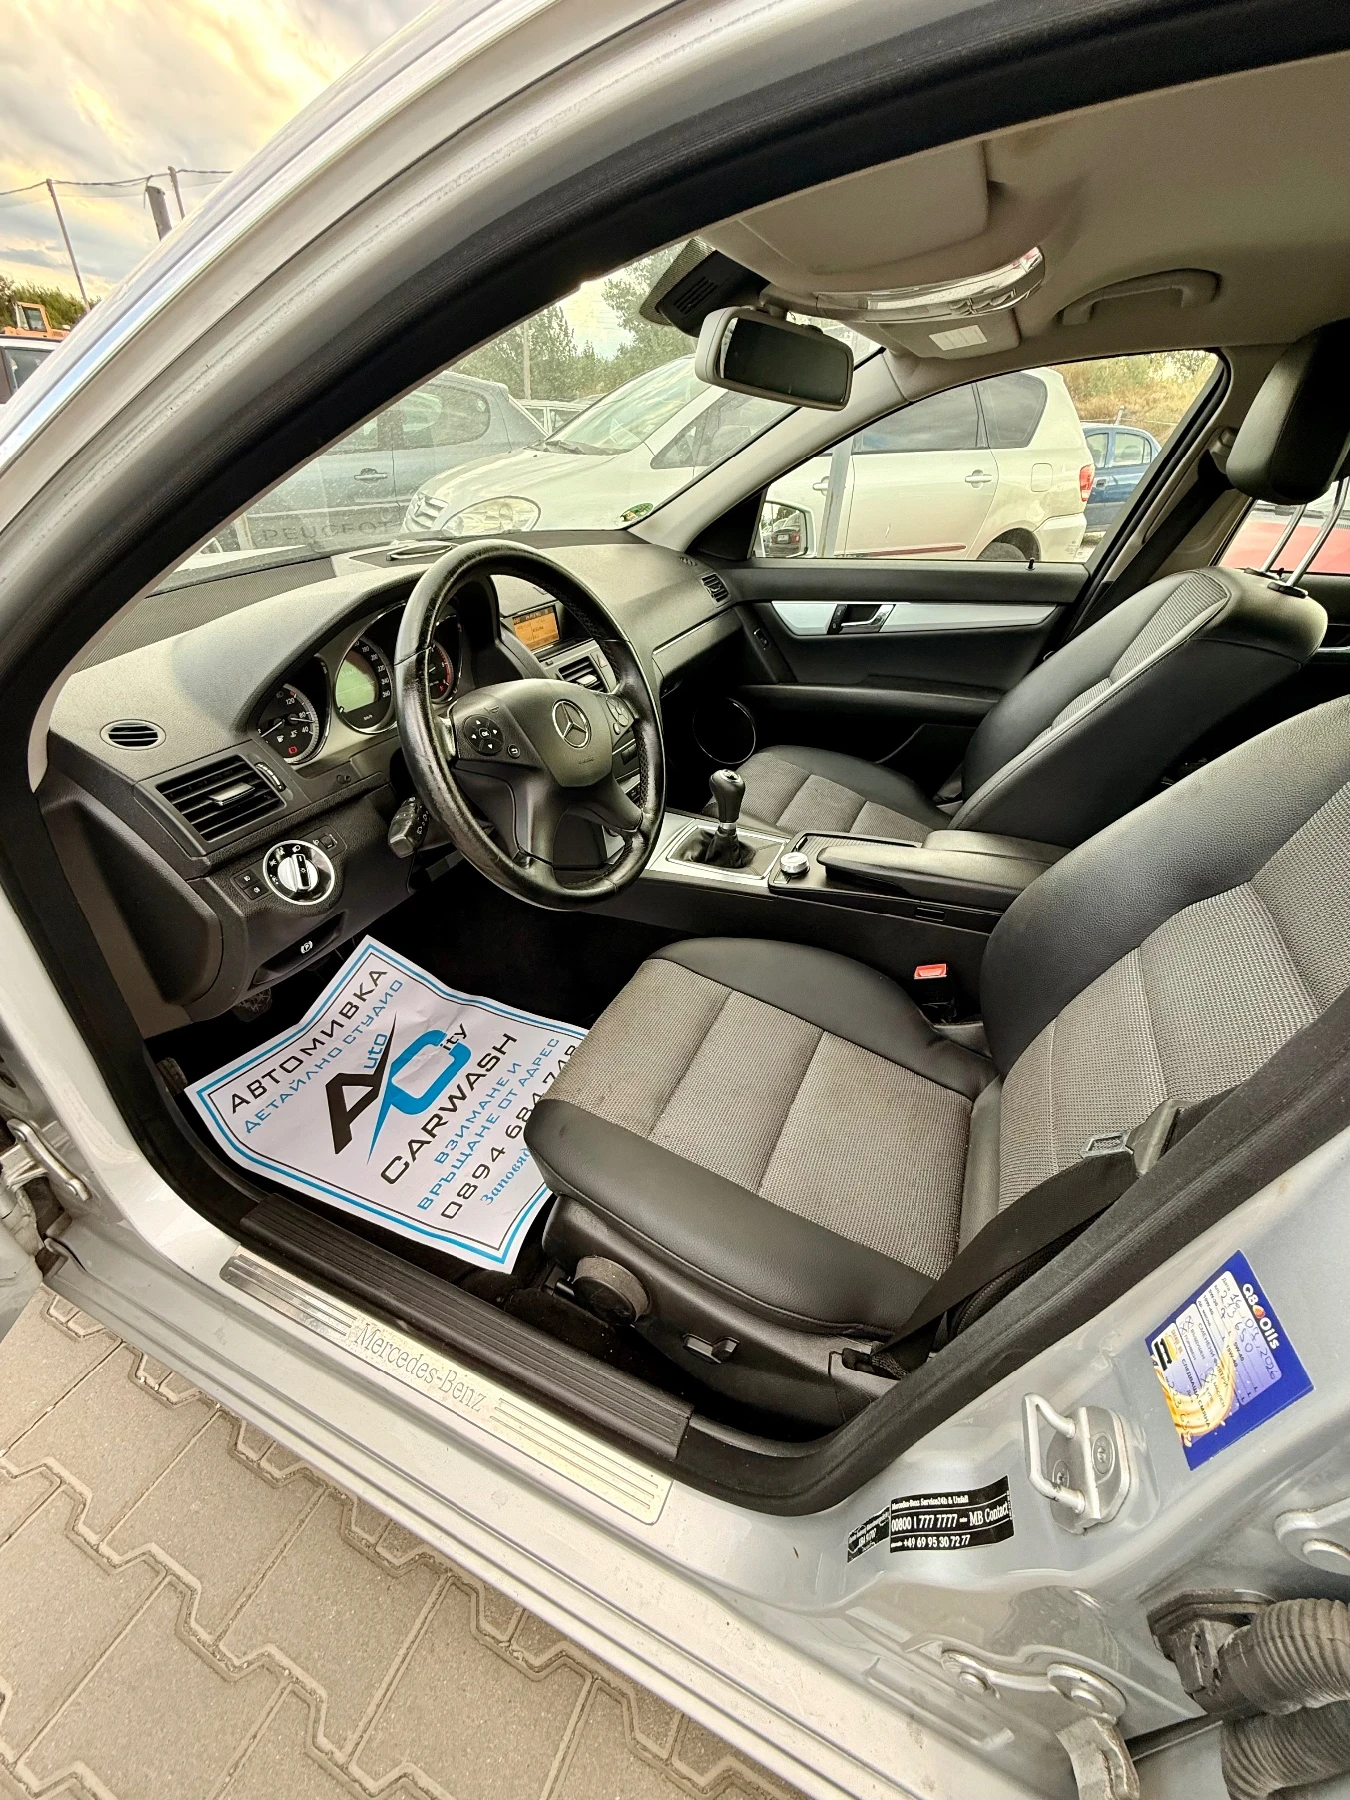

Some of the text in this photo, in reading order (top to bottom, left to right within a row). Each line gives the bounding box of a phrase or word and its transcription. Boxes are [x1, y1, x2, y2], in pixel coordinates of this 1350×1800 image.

[262, 521, 393, 541] PEUGEOT
[231, 970, 388, 1114] АВТОМИВКА
[245, 979, 403, 1133] ДЕТАЙЛНО СТУДИО
[380, 1033, 517, 1185] CARWASH
[417, 1038, 560, 1211] ВРЪЩАНЕ ОТ АДРЕС
[434, 1062, 522, 1164] ВЗИМАНЕ И
[440, 1146, 505, 1219] 0894
[1243, 1283, 1279, 1349] Q8 Oils
[354, 1323, 487, 1412] Mercedes-Benz
[891, 1516, 912, 1532] 00800
[969, 1511, 983, 1526] MB
[985, 1501, 1009, 1522] Contact
[904, 1537, 916, 1548] +49
[917, 1537, 926, 1547] 69
[928, 1537, 937, 1547] 95
[939, 1537, 949, 1547] 30
[950, 1536, 960, 1547] 72
[961, 1535, 970, 1546] 77
